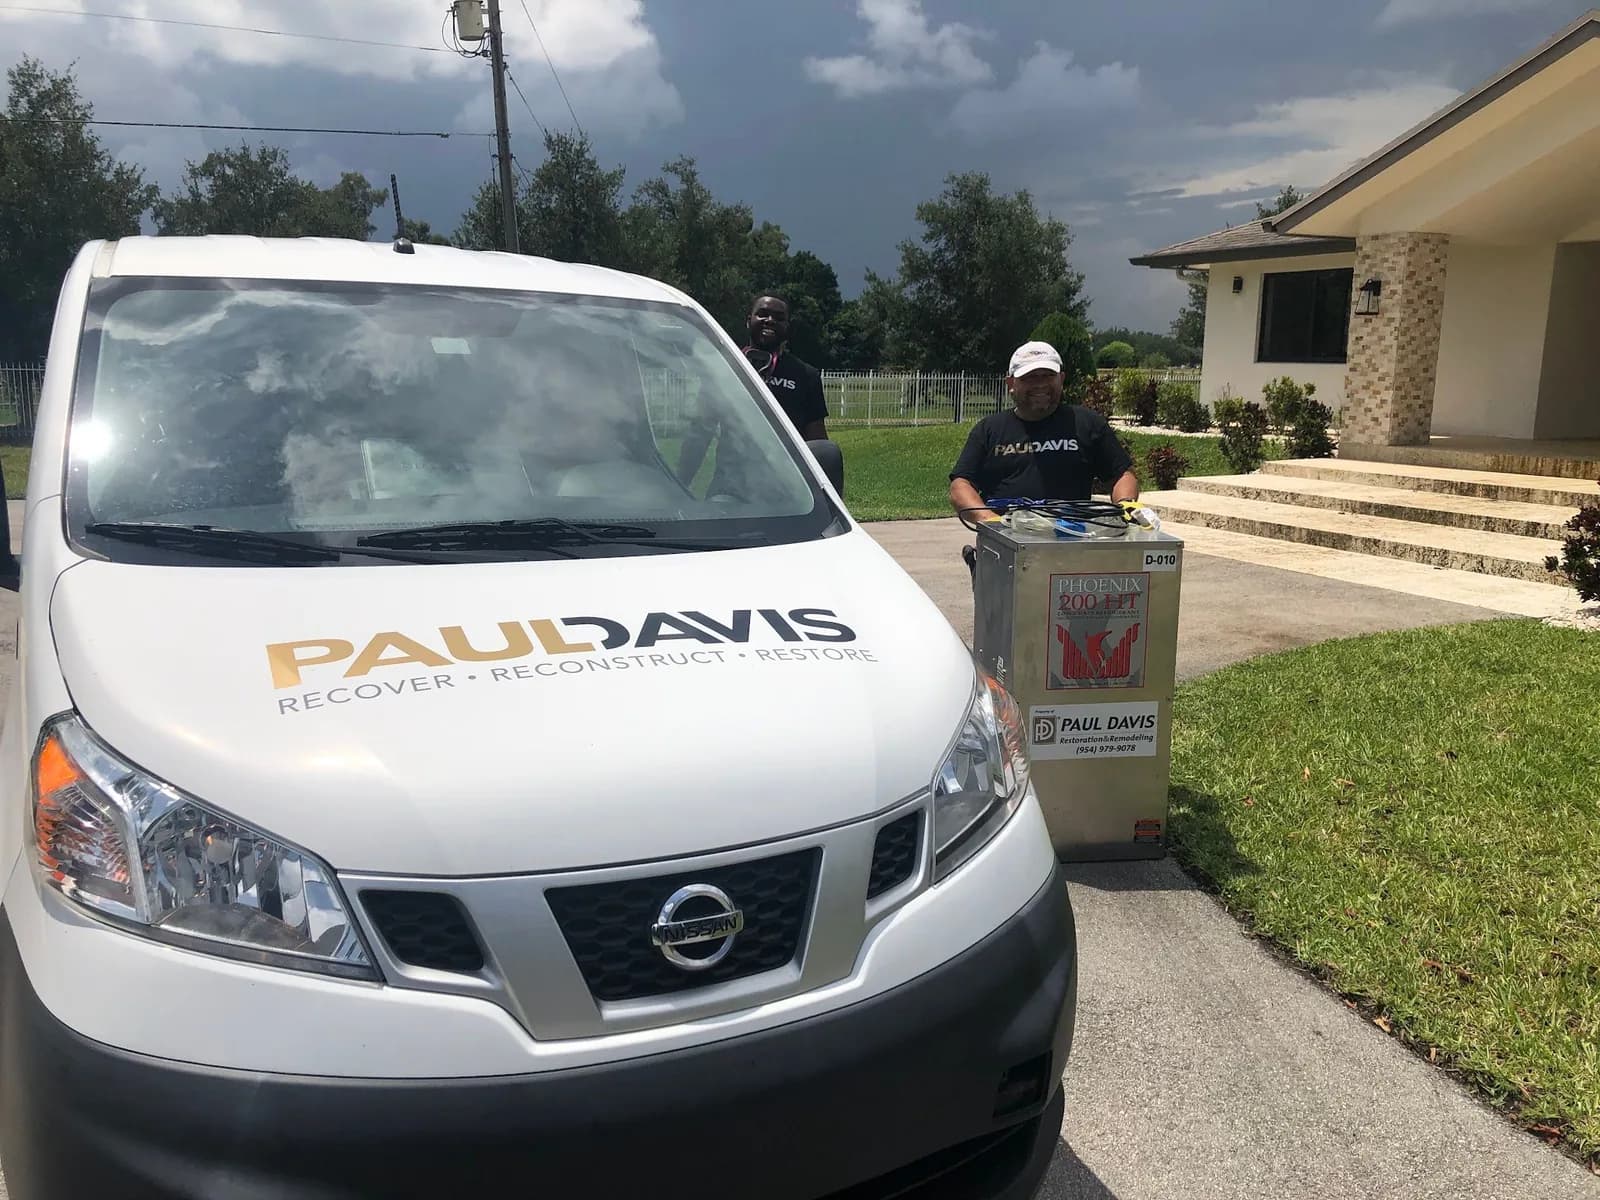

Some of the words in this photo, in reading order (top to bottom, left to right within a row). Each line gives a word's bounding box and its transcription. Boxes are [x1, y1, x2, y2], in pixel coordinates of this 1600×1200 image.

[1145, 555, 1176, 565] D-010
[1058, 577, 1143, 593] PHOENIX
[1058, 594, 1097, 611] 200
[1104, 592, 1140, 610] HT
[278, 674, 455, 715] RECOVER
[490, 650, 725, 682] RECONSTRUCT
[755, 648, 879, 663] RESTORE
[1060, 717, 1102, 732] PAUL
[1107, 715, 1156, 730] DAVIS
[1075, 745, 1098, 755] (954)
[1099, 744, 1136, 753] 979-9078
[664, 914, 737, 942] NISSAN
